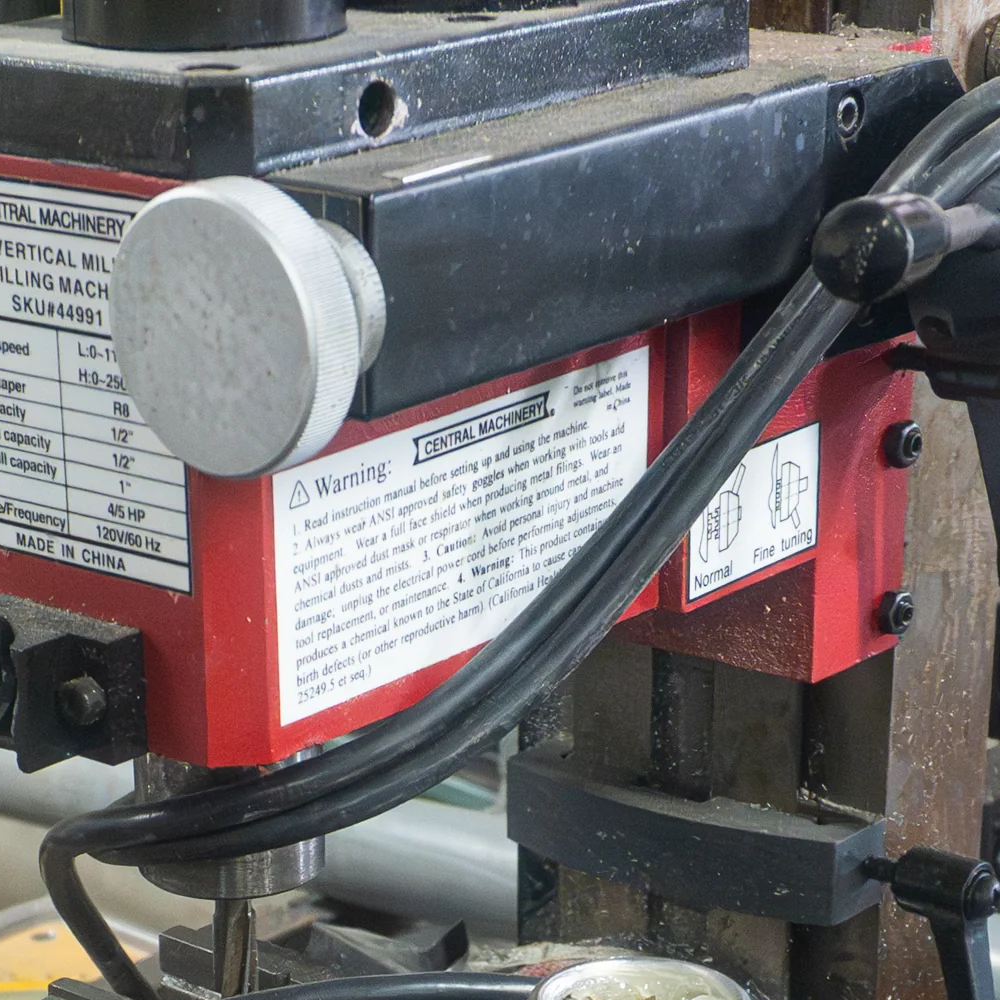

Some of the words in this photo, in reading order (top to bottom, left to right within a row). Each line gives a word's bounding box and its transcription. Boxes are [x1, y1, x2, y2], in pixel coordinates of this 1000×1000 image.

[39, 208, 127, 238] MACHINERY
[12, 295, 103, 326] SKU#44991
[113, 402, 130, 418] R8
[425, 425, 475, 456] CENTRAL
[478, 401, 544, 437] MACHINERY
[3, 428, 51, 452] capacity
[9, 453, 57, 480] capacity
[304, 512, 328, 532] Read
[332, 497, 381, 521] instruction
[384, 480, 416, 503] manual
[419, 472, 447, 490] before
[450, 460, 479, 479] setting
[481, 456, 493, 469] up
[495, 445, 510, 463] and
[512, 440, 535, 456] using
[537, 433, 551, 447] the
[305, 531, 340, 551] Always
[369, 506, 395, 527] ANSI
[398, 491, 438, 518] approved
[442, 484, 467, 500] safety
[472, 469, 505, 492] goggles
[507, 460, 530, 475] when
[532, 446, 566, 465] working
[589, 429, 609, 445] tools
[610, 422, 625, 438] and
[314, 459, 392, 500] Warning:
[107, 503, 126, 521] 4/5
[127, 507, 146, 524] HP
[356, 535, 379, 549] Wear
[390, 521, 406, 538] full
[409, 517, 427, 531] face
[430, 503, 456, 523] shield
[459, 496, 482, 511] when
[485, 479, 527, 506] producing
[530, 466, 553, 485] metal
[590, 448, 611, 461] Wear
[612, 444, 622, 454] an
[96, 525, 142, 549] 120V/60
[145, 535, 161, 553] Hz
[294, 586, 336, 612] chemical
[340, 579, 363, 595] dusts
[366, 567, 383, 584] and
[436, 535, 476, 556] Caution:
[482, 519, 507, 540] Avoid
[509, 505, 544, 532] personal
[573, 487, 588, 504] and
[590, 478, 623, 497] machine
[295, 572, 321, 593] ANSI
[325, 555, 367, 583] approved
[370, 549, 389, 564] dust
[392, 538, 415, 556] mask
[418, 535, 427, 546] or
[430, 518, 471, 541] respirator
[474, 508, 497, 524] when
[499, 494, 534, 514] working
[536, 479, 565, 501] around
[594, 463, 609, 479] and
[753, 542, 775, 564] Fine
[781, 528, 813, 550] tuning
[16, 532, 55, 555] MADE
[61, 543, 76, 560] IN
[81, 548, 127, 572] CHINA
[376, 586, 390, 599] the
[393, 566, 434, 592] electrical
[436, 557, 464, 578] power
[466, 545, 486, 563] cord
[488, 537, 515, 555] before
[518, 518, 564, 546] performing
[296, 632, 314, 649] tool
[379, 605, 389, 616] or
[471, 555, 514, 577] Warning:
[519, 544, 537, 560] This
[539, 532, 571, 555] product
[694, 560, 733, 591] Normal
[296, 644, 338, 671] produces
[350, 619, 390, 646] chemical
[393, 609, 423, 628] known
[425, 605, 434, 615] to
[437, 598, 450, 611] the
[453, 588, 474, 604] State
[476, 579, 487, 595] of
[488, 565, 530, 590] California
[532, 562, 541, 572] to
[543, 552, 566, 568] cause
[296, 669, 319, 687] birth
[322, 656, 355, 676] defects
[358, 649, 372, 664] (or
[374, 638, 398, 655] other
[401, 615, 455, 644] reproductive
[488, 581, 534, 610] (California
[338, 675, 347, 687] et
